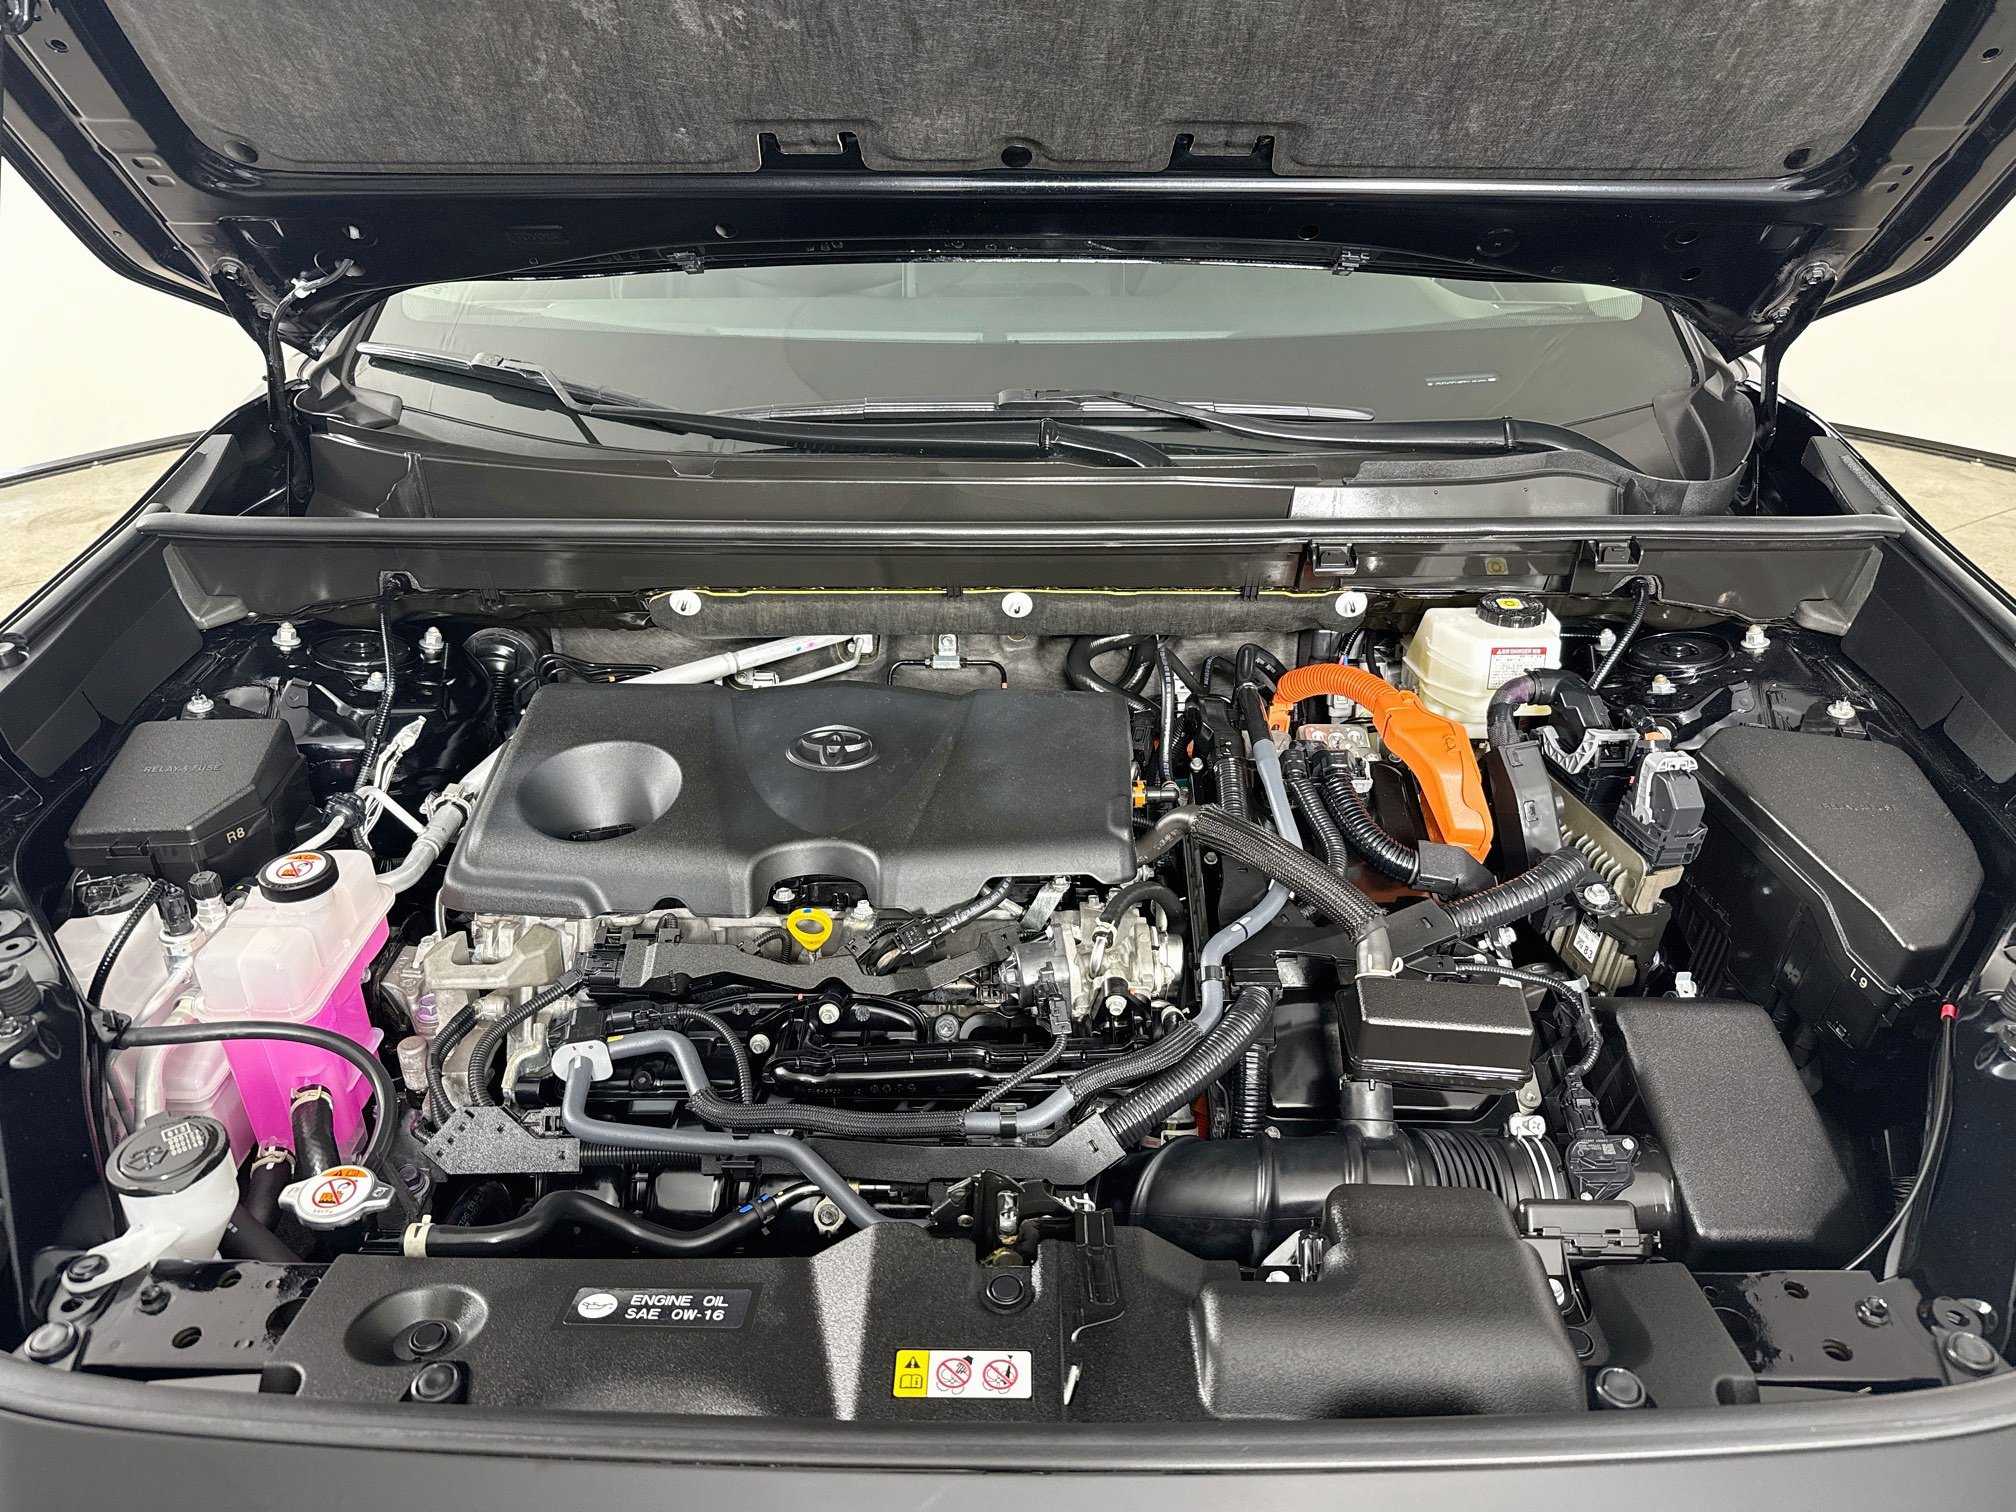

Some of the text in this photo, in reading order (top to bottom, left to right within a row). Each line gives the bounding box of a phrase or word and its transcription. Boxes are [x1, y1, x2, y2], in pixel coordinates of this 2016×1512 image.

[143, 765, 181, 773] RELAY
[191, 764, 223, 773] FUSE
[226, 827, 246, 844] R8
[630, 1294, 729, 1307] ENGINE OIL
[624, 1308, 725, 1321] SAE 0W-16
